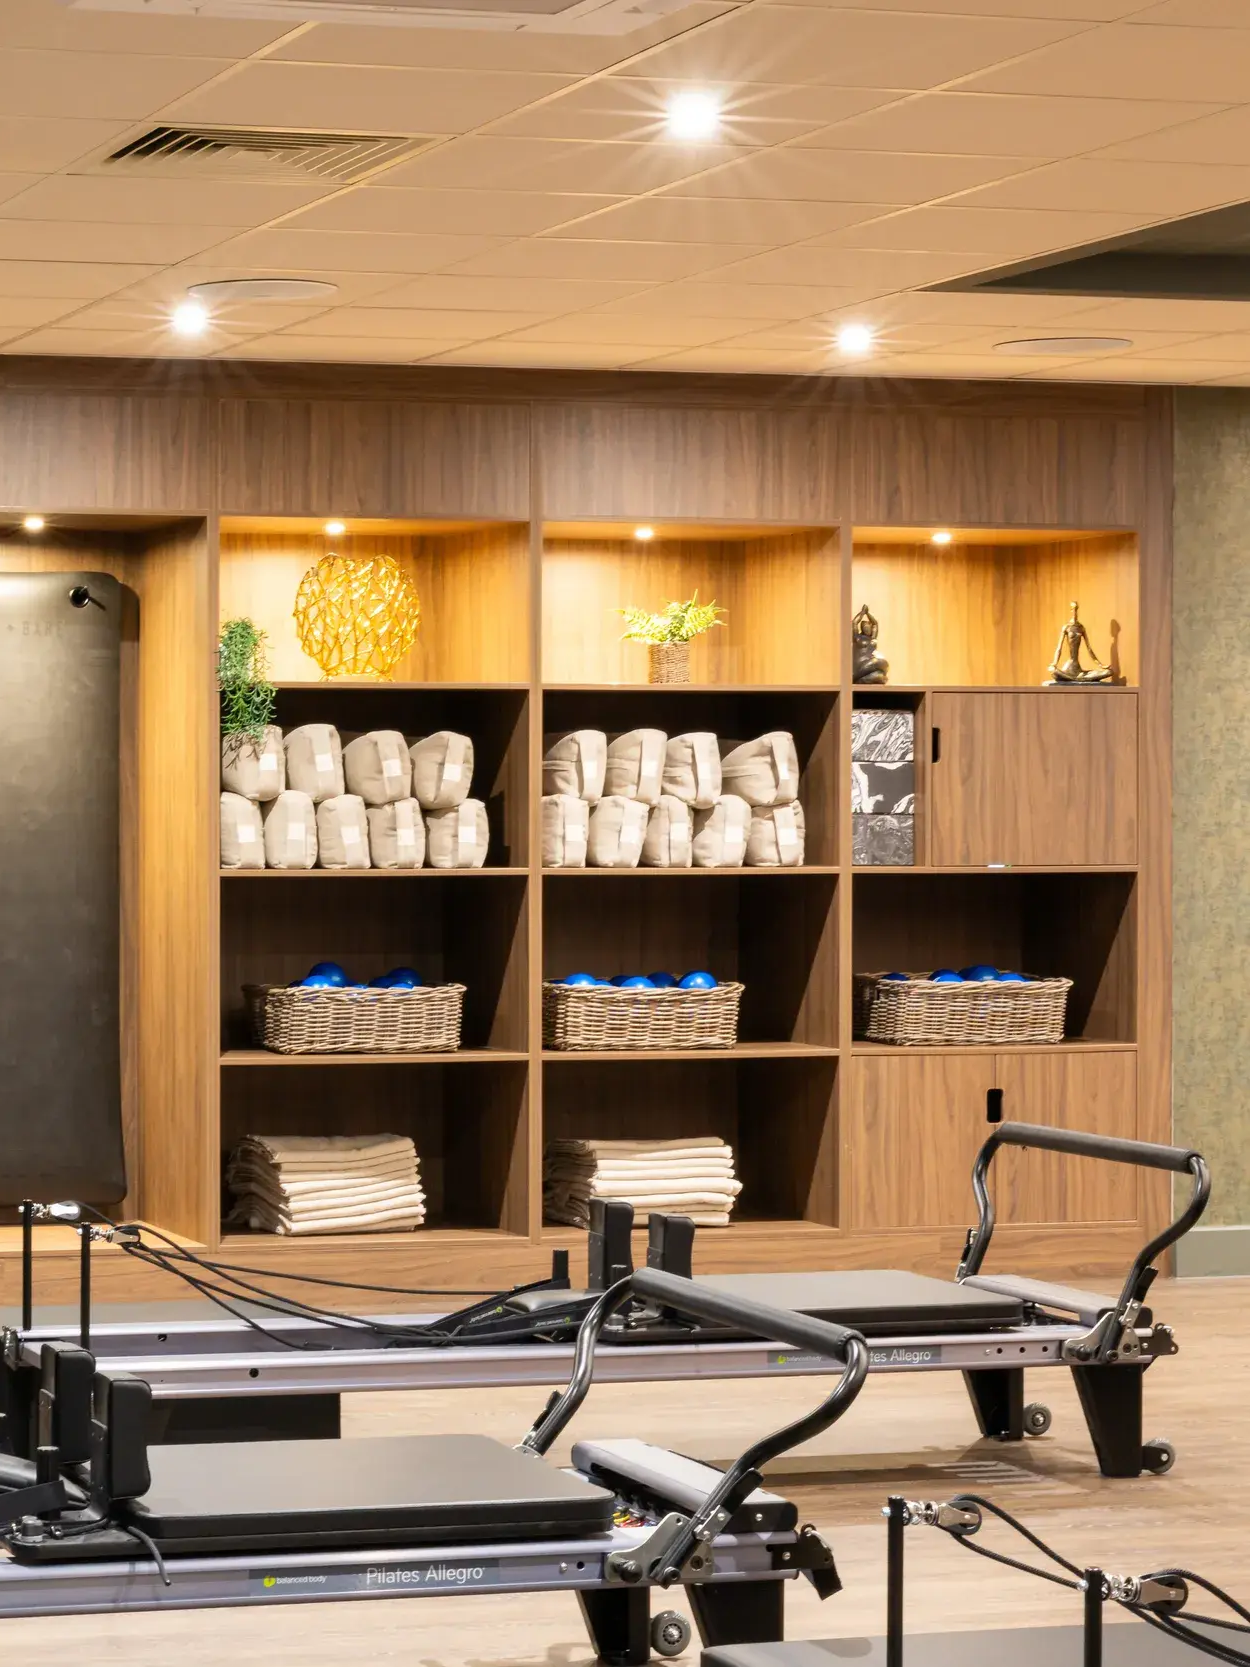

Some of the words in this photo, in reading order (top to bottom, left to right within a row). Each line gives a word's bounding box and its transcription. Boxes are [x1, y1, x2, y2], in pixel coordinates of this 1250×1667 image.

[22, 620, 65, 637] BARE
[890, 1348, 931, 1363] Allegro
[276, 1575, 308, 1585] balanced
[308, 1574, 327, 1584] body
[366, 1566, 420, 1585] Pilates
[425, 1564, 484, 1584] Allegro
